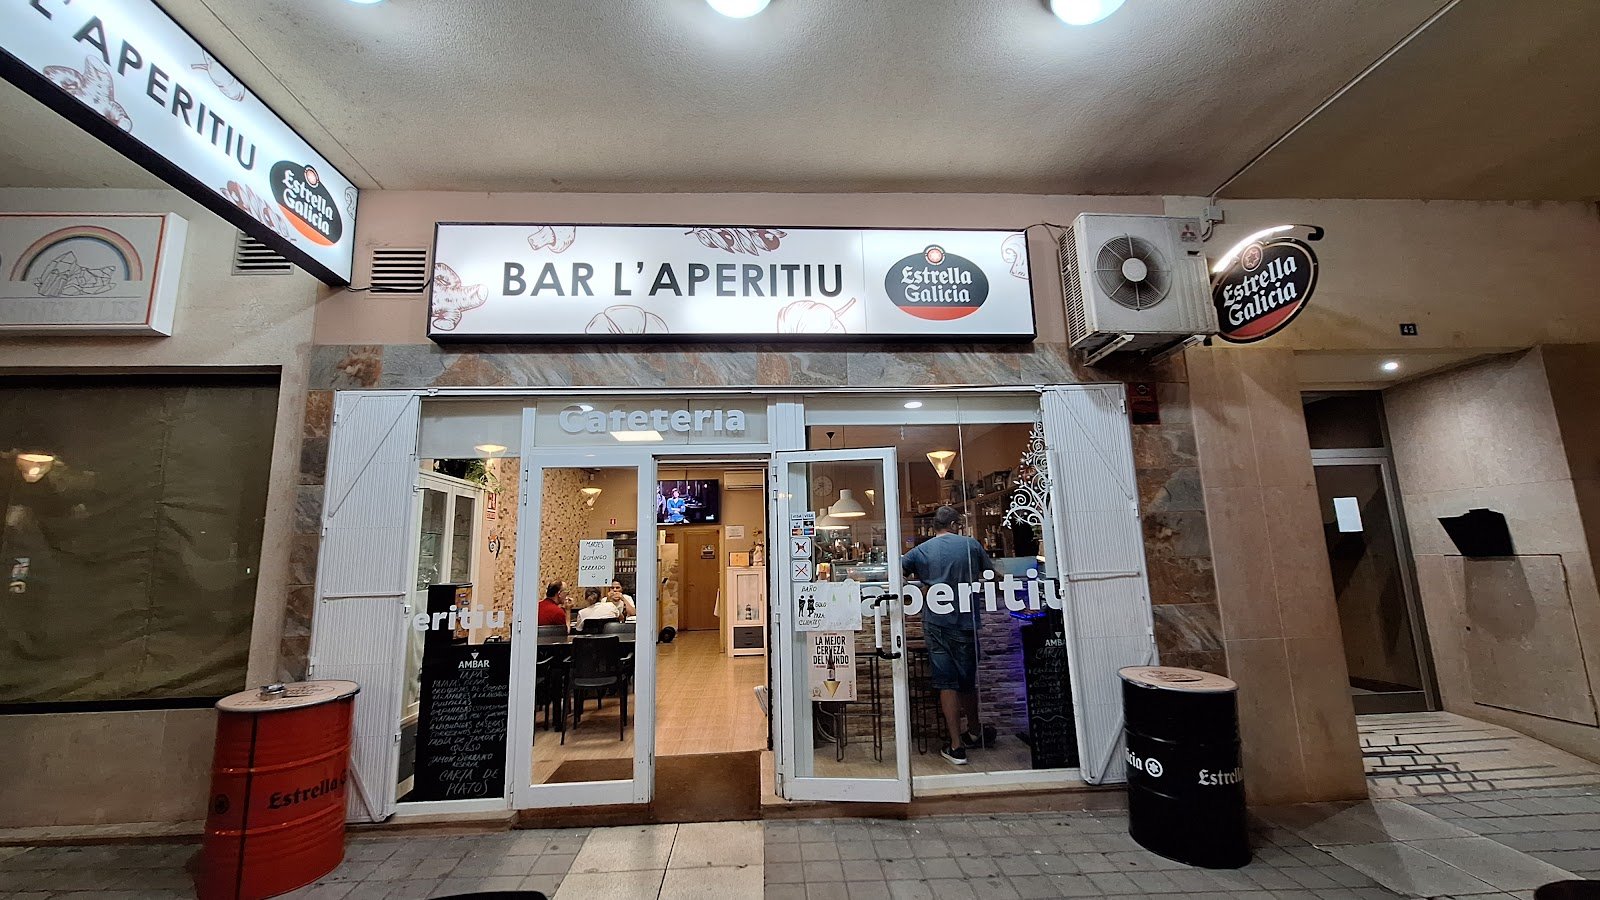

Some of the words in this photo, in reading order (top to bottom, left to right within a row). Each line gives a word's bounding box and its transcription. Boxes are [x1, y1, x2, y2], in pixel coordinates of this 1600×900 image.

[29, 0, 257, 171] APERITIU
[282, 169, 333, 220] Estrella
[283, 188, 329, 235] Galicia
[502, 261, 594, 297] BAR
[614, 261, 842, 297] L'APERITIU
[901, 265, 972, 285] Estrella
[1223, 256, 1298, 307] Estrella
[904, 284, 970, 303] Galicia
[1229, 281, 1298, 326] Galicia
[801, 585, 817, 593] BAÑO
[815, 636, 823, 646] LA
[824, 636, 846, 646] MEJOR
[458, 659, 490, 669] AMBAR
[813, 655, 824, 665] DEL
[268, 777, 338, 810] Estrella
